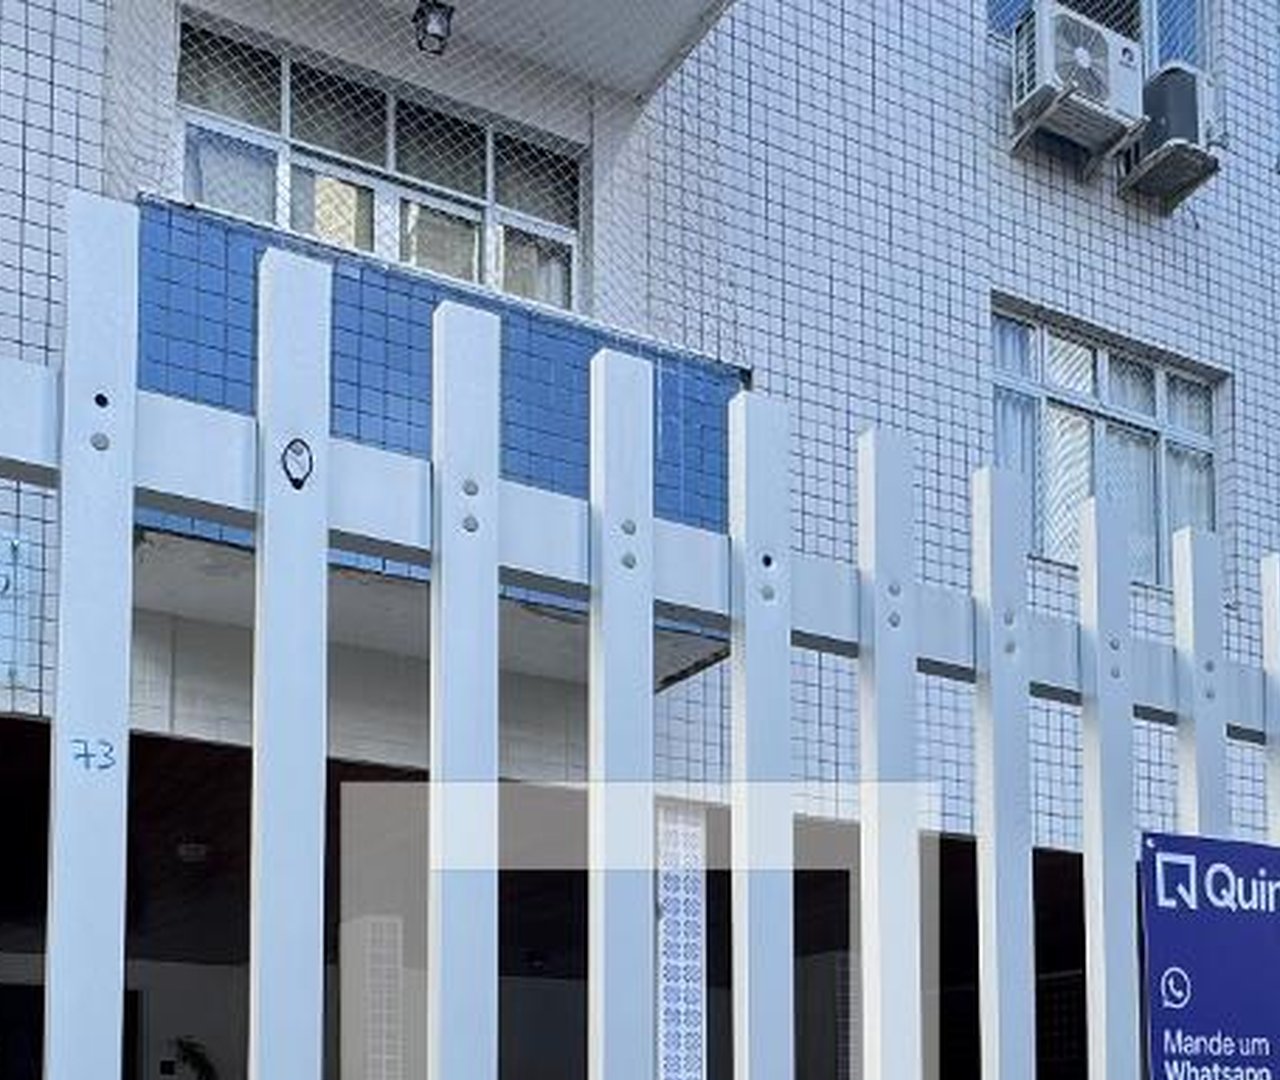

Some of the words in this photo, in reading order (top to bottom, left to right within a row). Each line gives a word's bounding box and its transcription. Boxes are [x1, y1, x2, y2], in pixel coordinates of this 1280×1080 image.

[71, 738, 117, 770] 73
[1163, 1030, 1235, 1057] Mande
[1239, 1036, 1270, 1057] um
